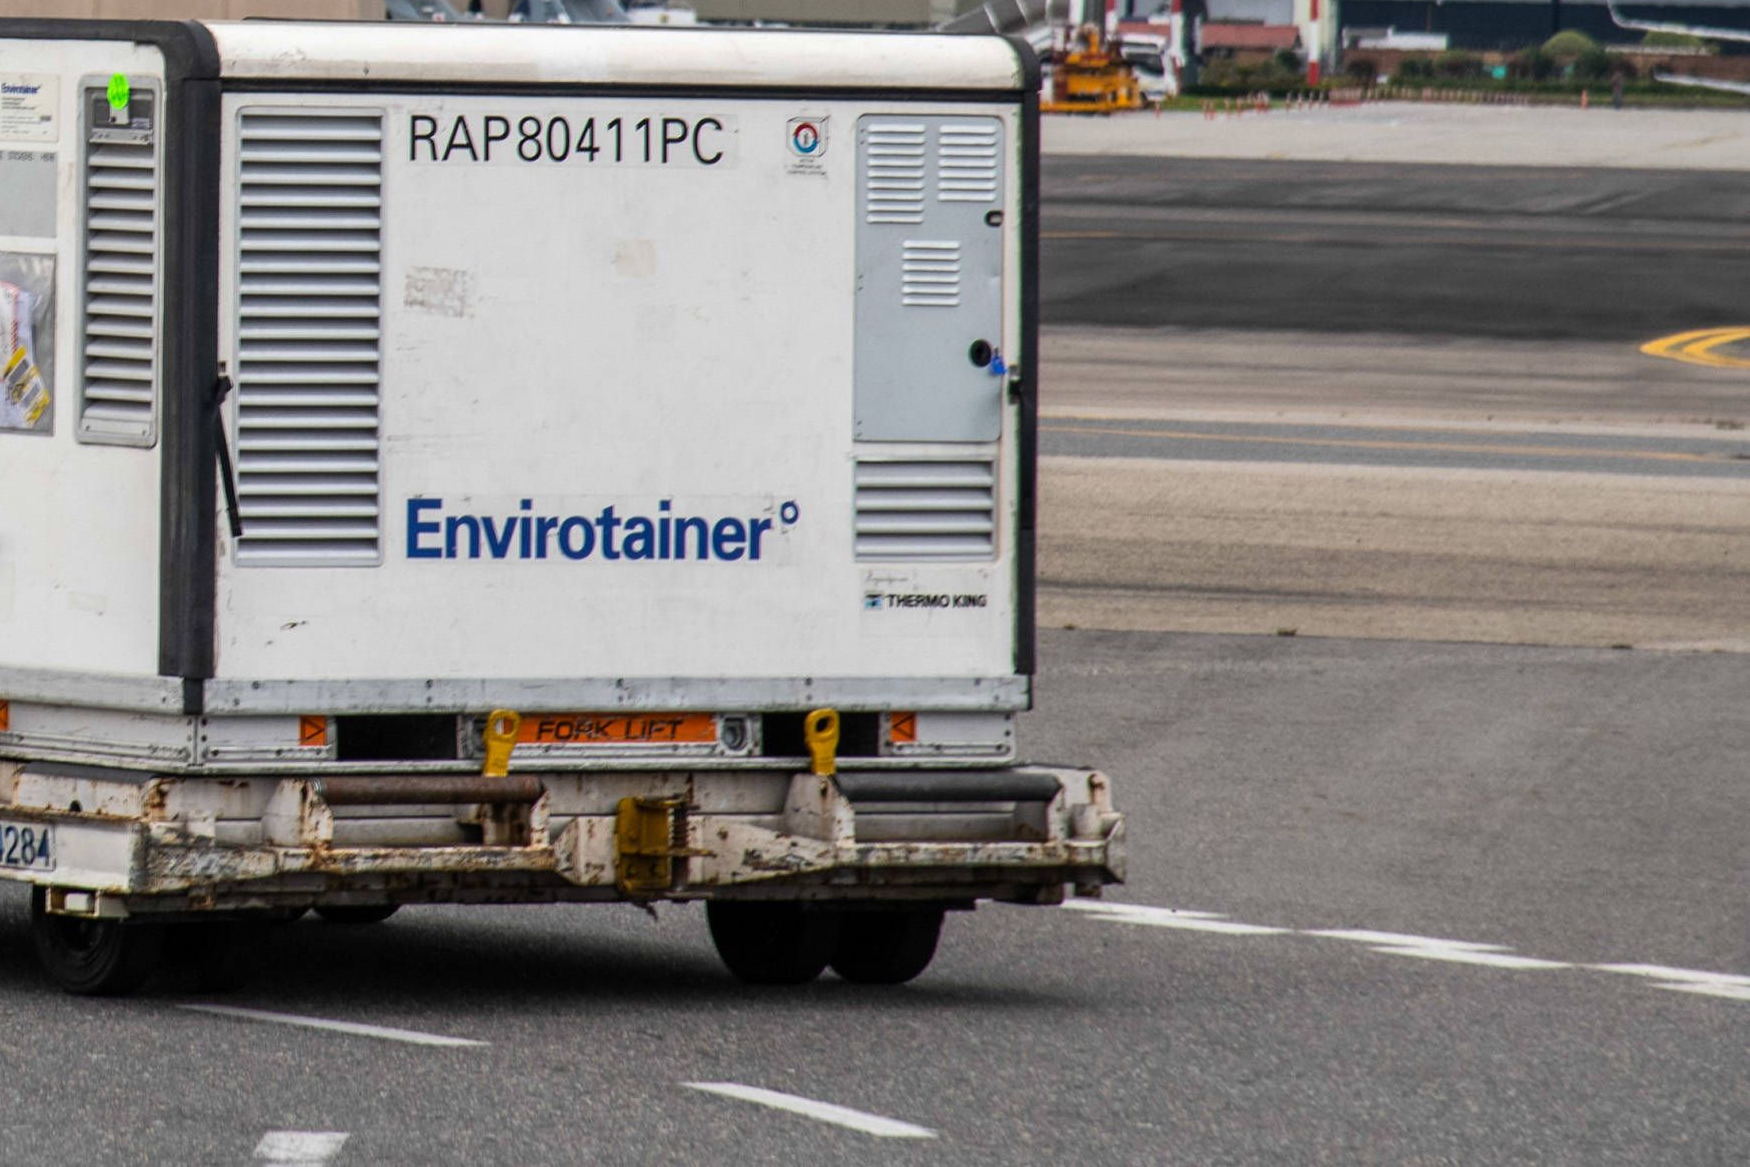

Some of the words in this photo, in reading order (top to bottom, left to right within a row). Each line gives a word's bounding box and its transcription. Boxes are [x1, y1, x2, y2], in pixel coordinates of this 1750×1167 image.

[409, 115, 723, 165] RAP80411PC
[886, 593, 951, 609] THERMO
[952, 593, 988, 608] KING
[536, 720, 615, 741] FORK
[624, 720, 685, 740] LIFT
